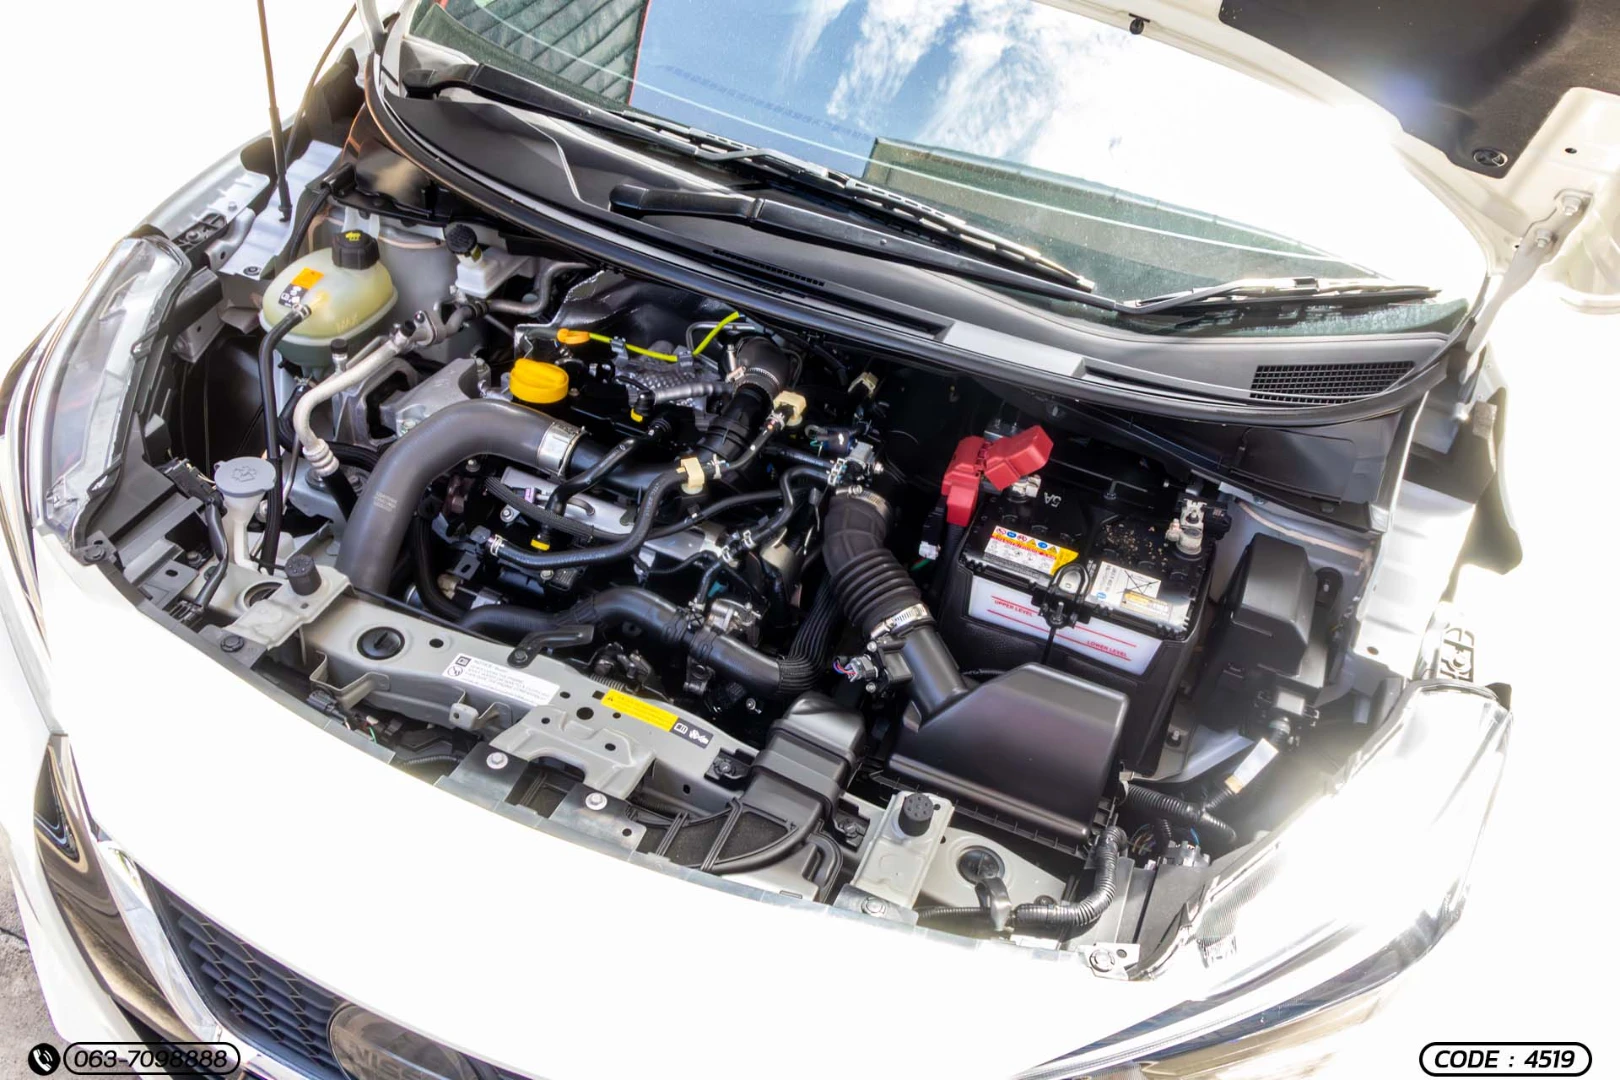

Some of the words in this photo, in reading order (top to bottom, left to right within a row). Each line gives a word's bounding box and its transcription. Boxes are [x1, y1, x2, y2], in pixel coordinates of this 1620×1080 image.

[994, 599, 1014, 610] UPPER
[1014, 606, 1033, 617] LEVEL
[1087, 640, 1108, 652] LOWER
[1109, 647, 1128, 658] LEVEL
